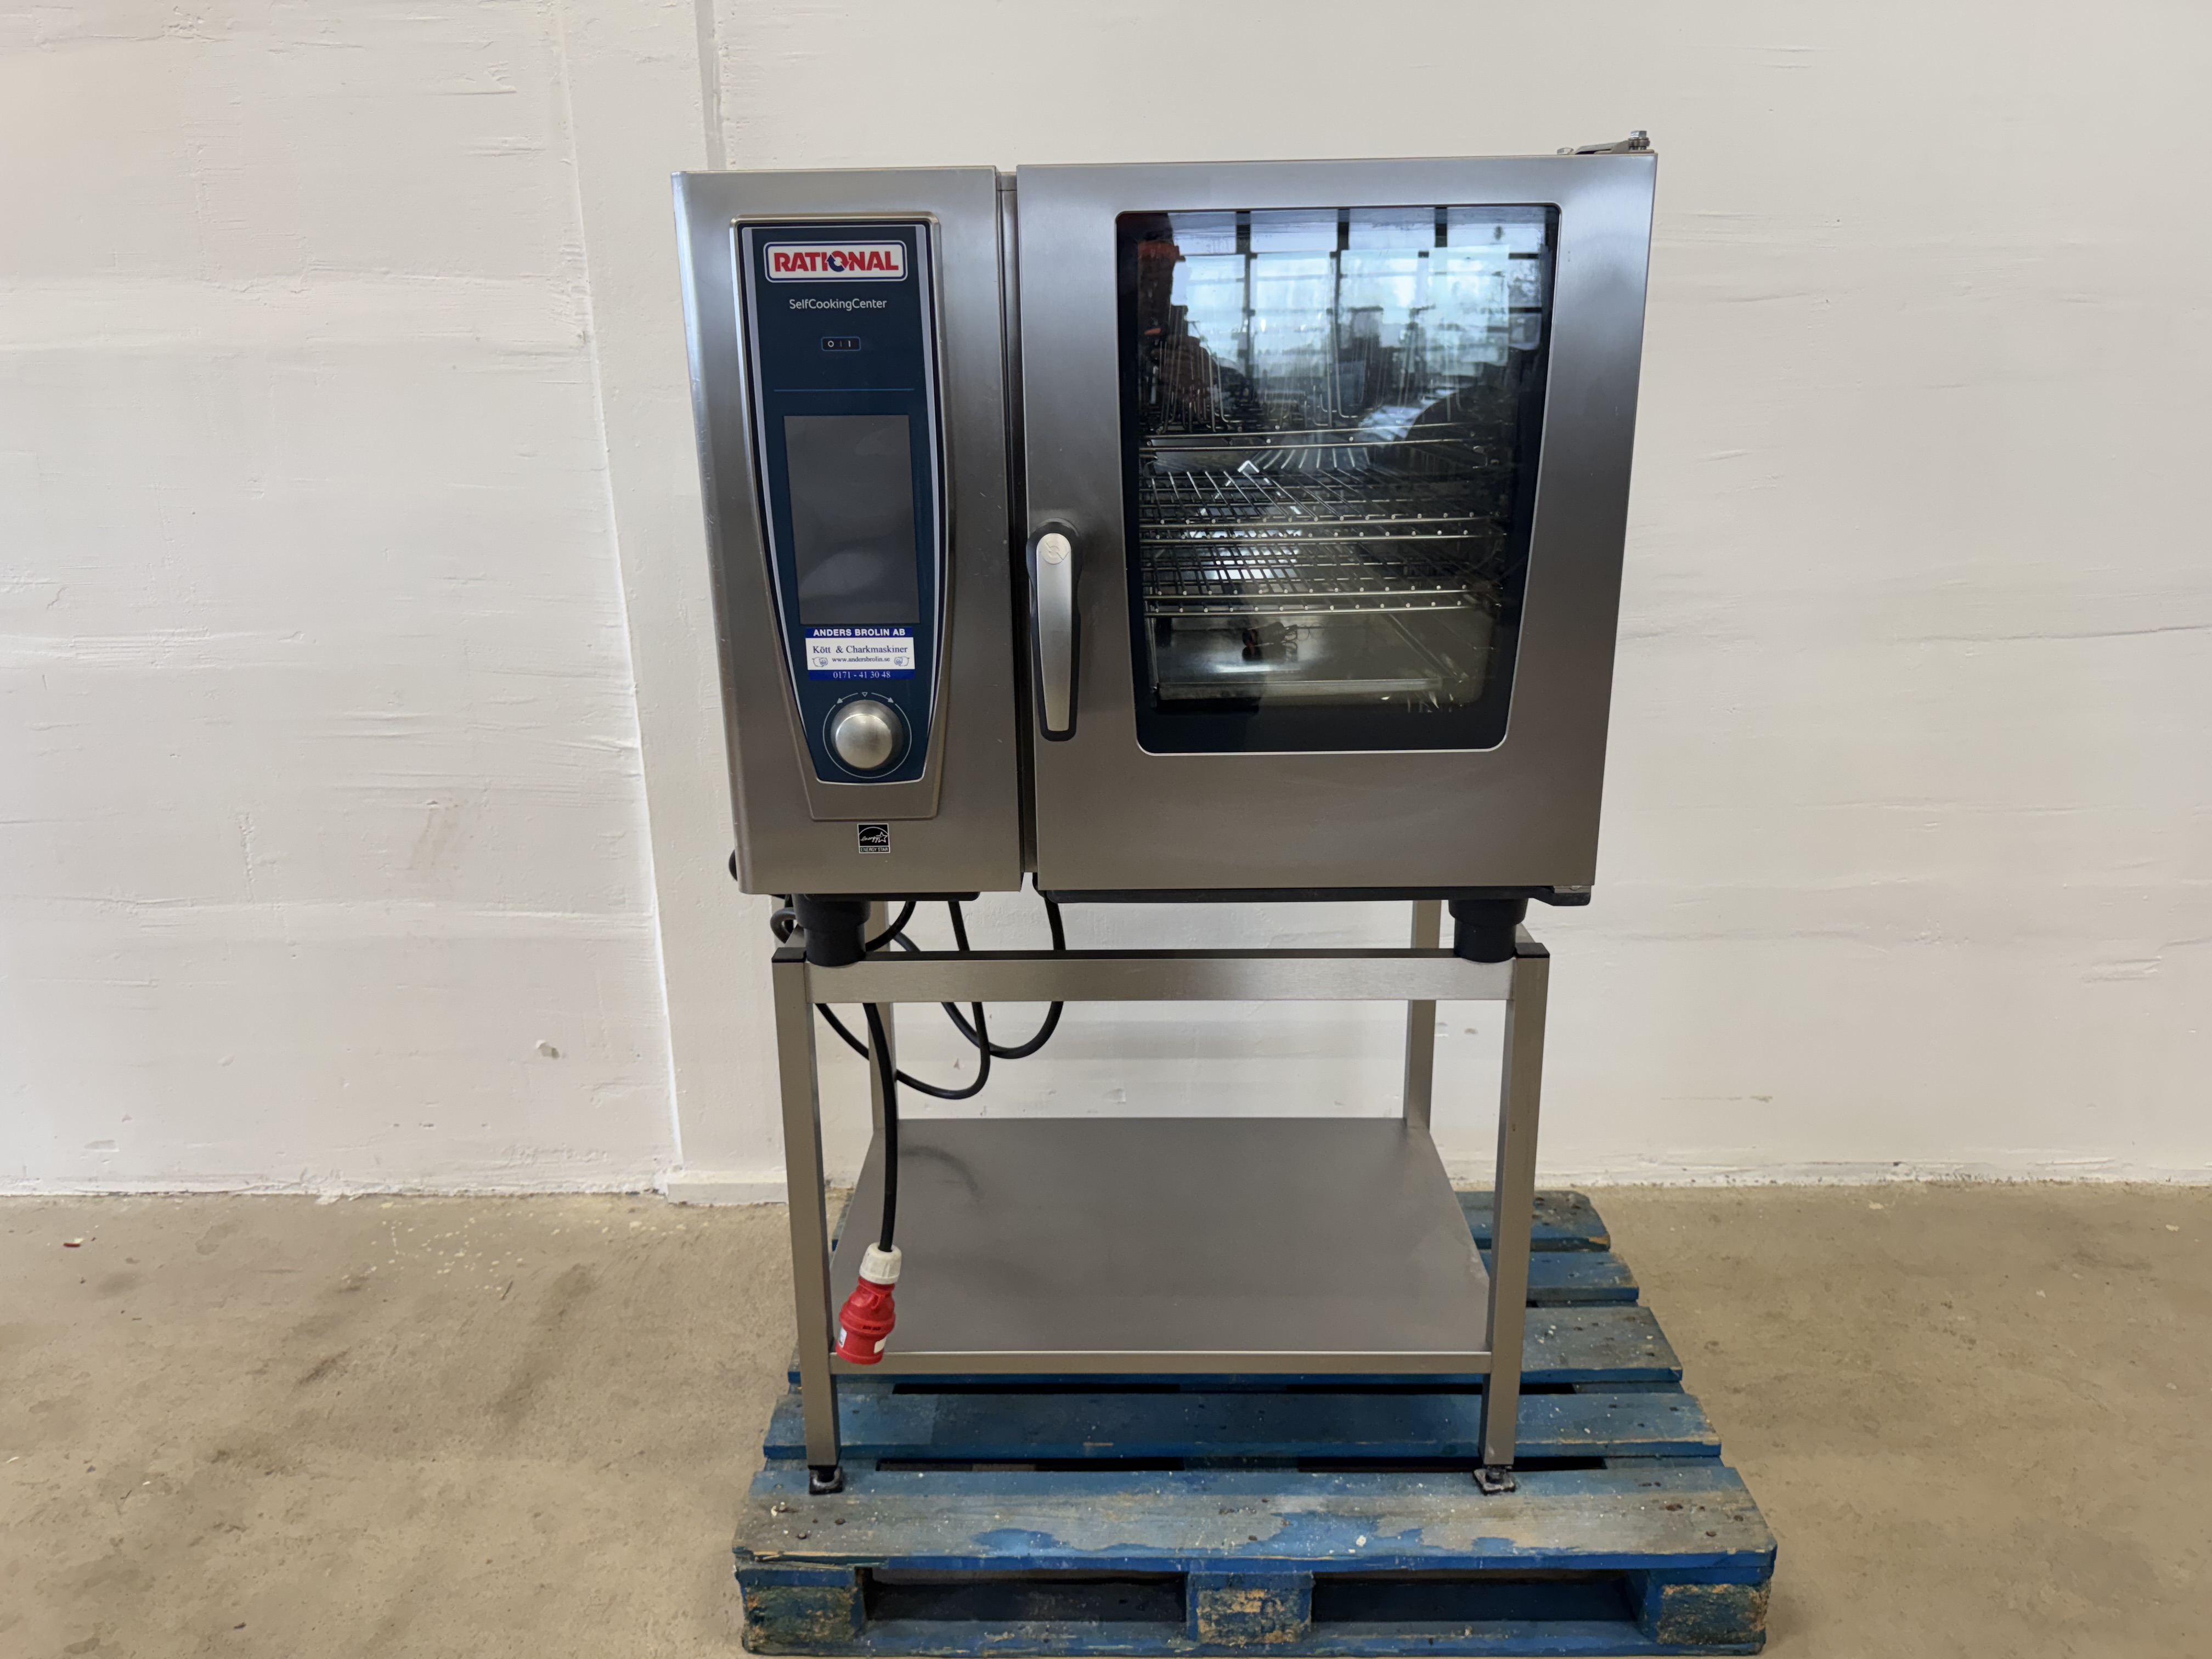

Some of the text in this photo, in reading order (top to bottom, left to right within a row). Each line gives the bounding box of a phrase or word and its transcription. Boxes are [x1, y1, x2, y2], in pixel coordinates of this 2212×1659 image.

[774, 251, 899, 272] RATIONAL
[789, 298, 887, 311] SelfCookingCenter
[812, 646, 831, 654] Kött
[846, 645, 908, 653] Charkmaskiner
